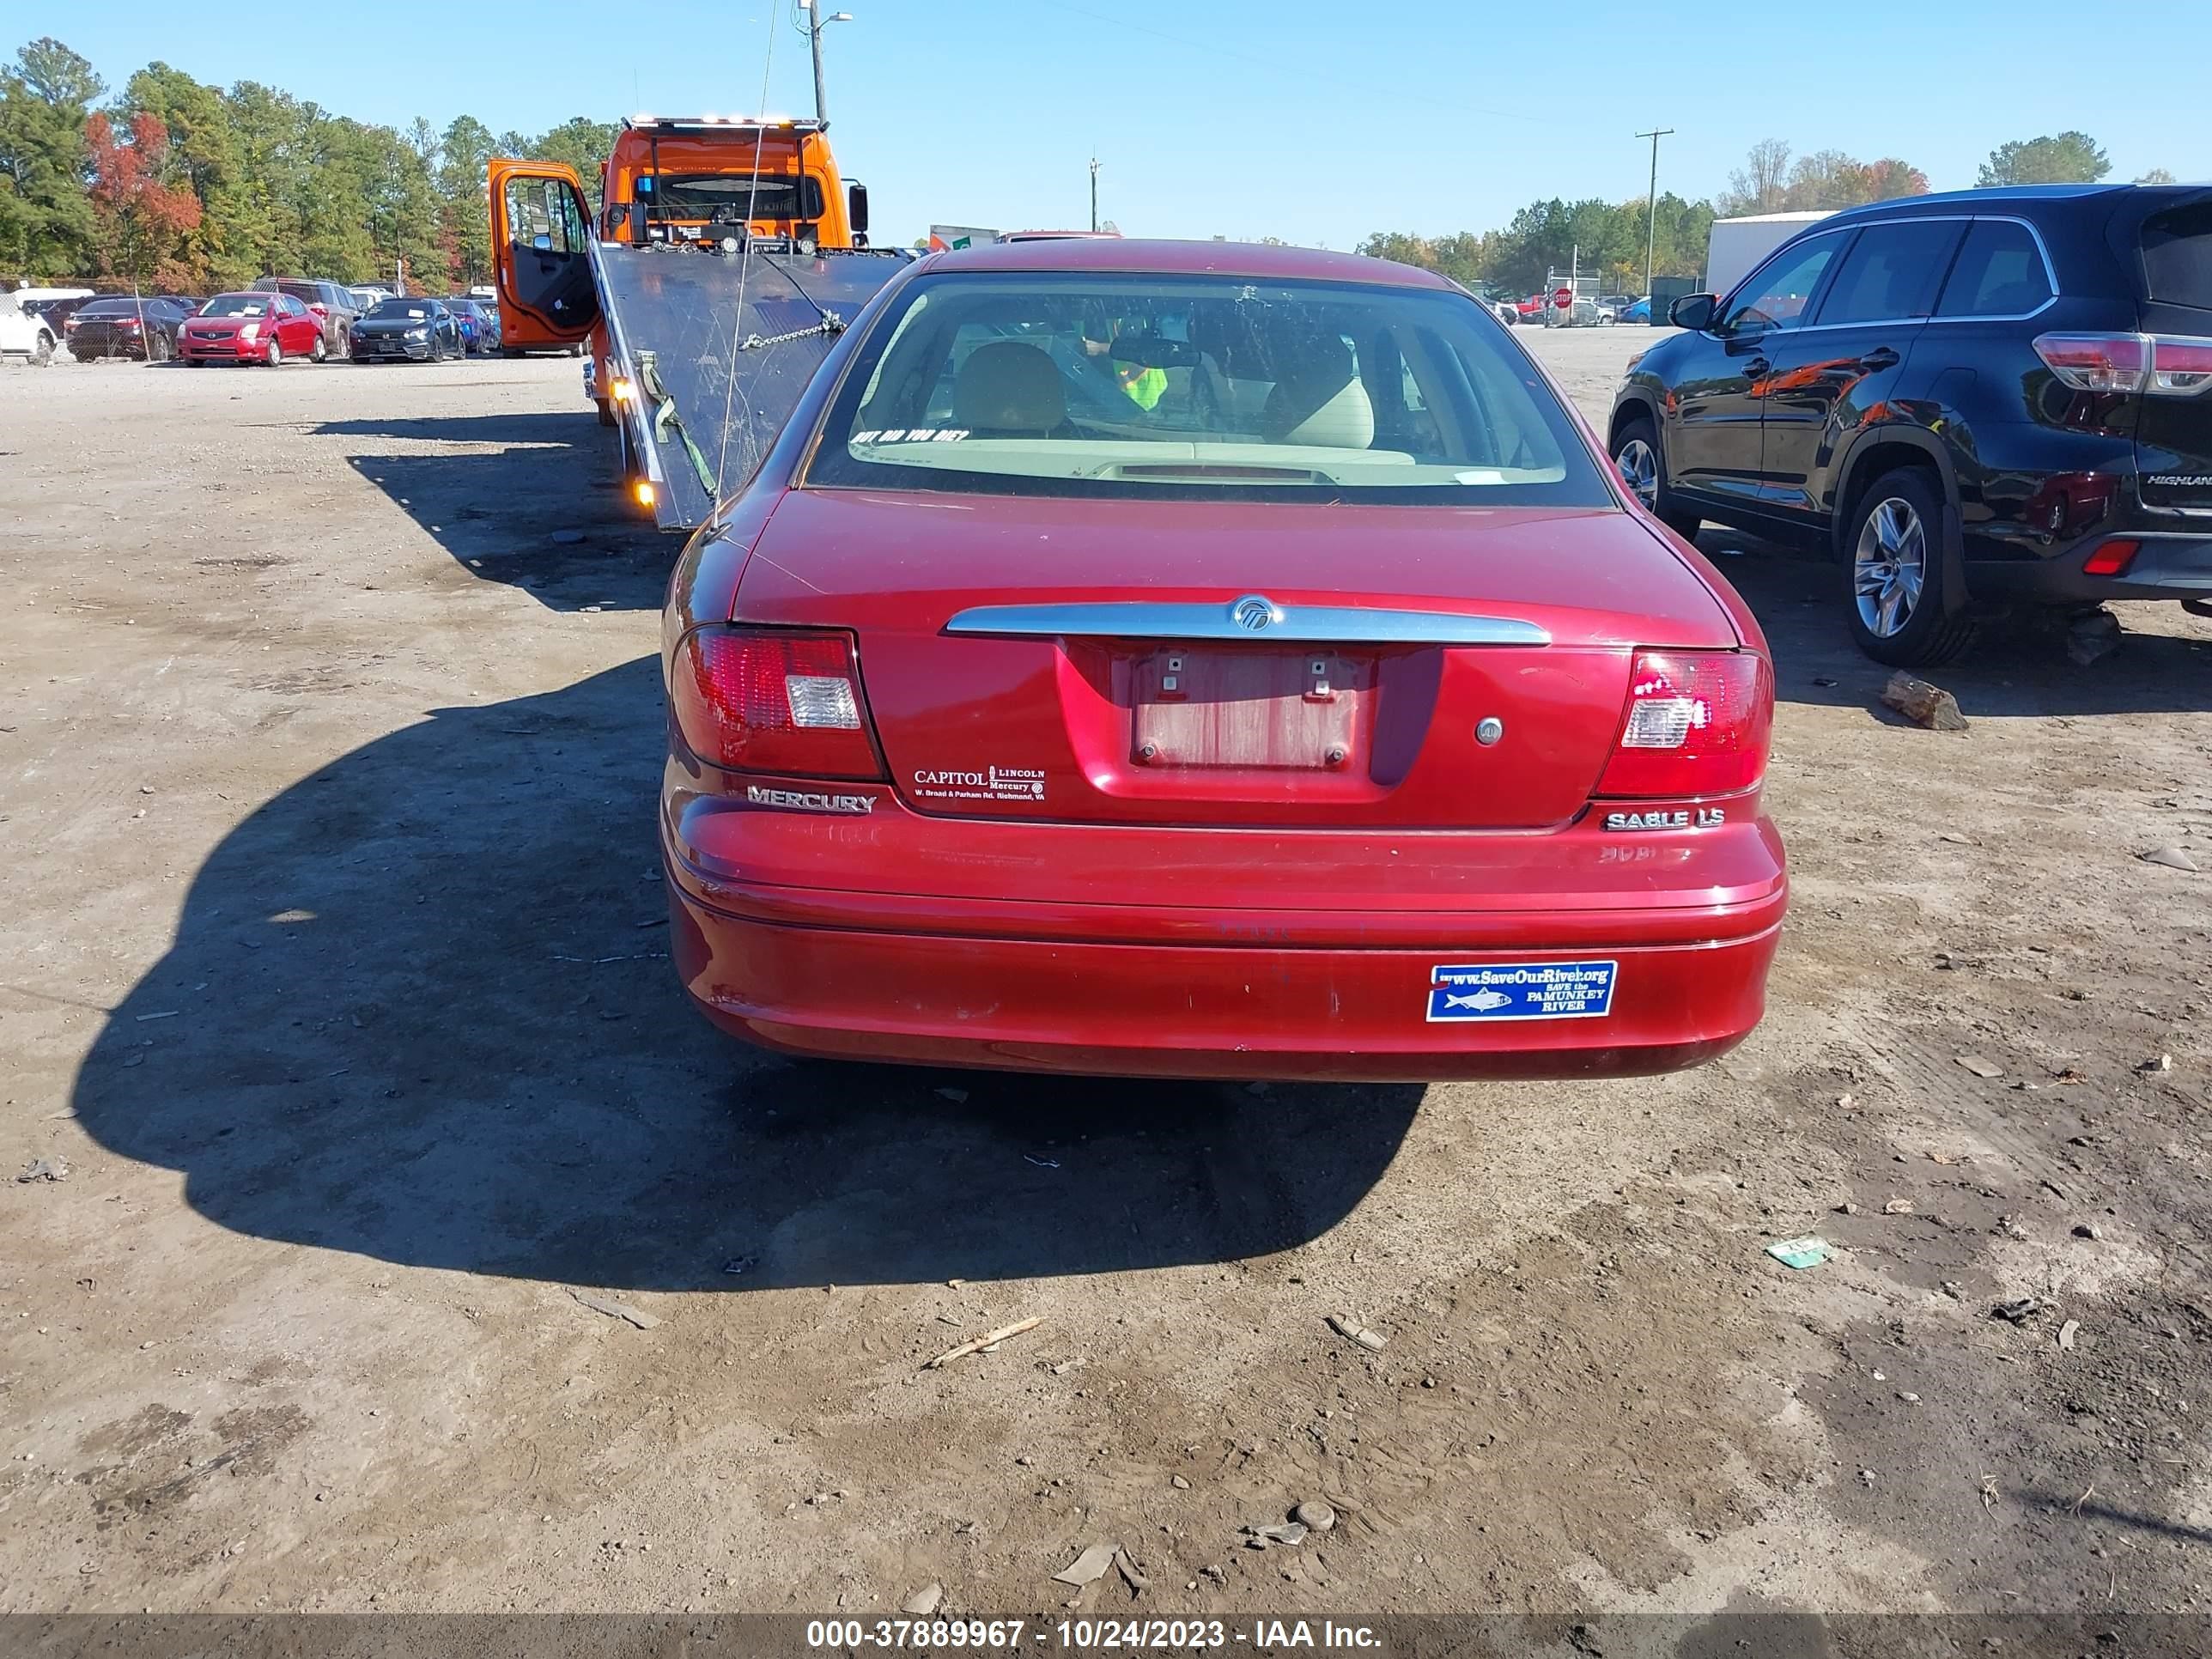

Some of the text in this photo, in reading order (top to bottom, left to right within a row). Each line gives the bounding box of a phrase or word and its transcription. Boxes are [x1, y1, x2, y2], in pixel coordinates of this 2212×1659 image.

[1555, 294, 1572, 303] STOP
[904, 429, 936, 441] YOU
[915, 770, 988, 786] CAPITOL
[999, 769, 1044, 778] LINCOLN
[989, 782, 1029, 793] Mercury
[747, 785, 878, 814] MERCURY
[926, 789, 947, 798] Broad
[955, 791, 982, 799] Parham
[1607, 807, 1725, 830] SABLE LS
[1439, 969, 1609, 986] www.SaveOurRiver.org
[1546, 983, 1571, 992] SAVE
[1526, 989, 1606, 1003] PAMUNKEY
[1541, 1000, 1586, 1012] RIVER
